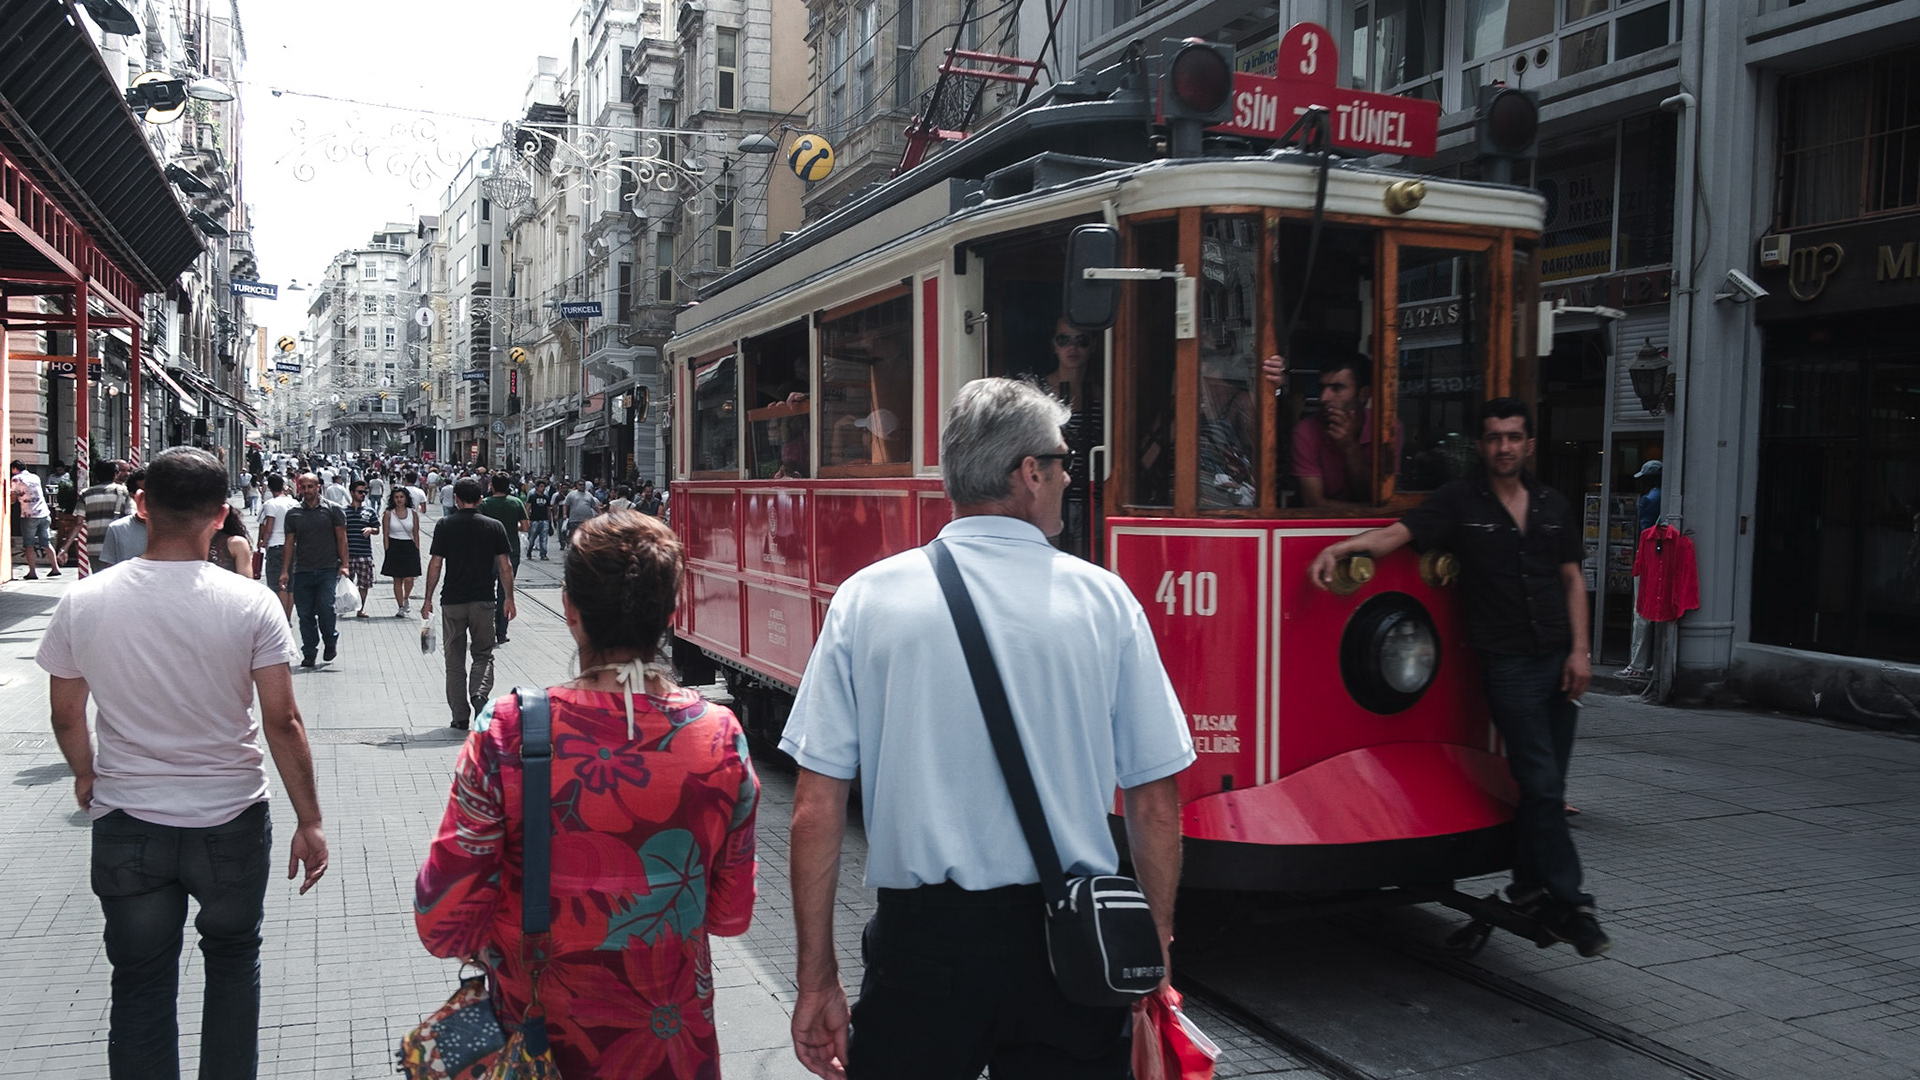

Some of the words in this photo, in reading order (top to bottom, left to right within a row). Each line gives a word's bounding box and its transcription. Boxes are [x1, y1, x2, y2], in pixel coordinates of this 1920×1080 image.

[1300, 32, 1319, 75] 3
[1233, 85, 1278, 132] SİM
[1336, 99, 1413, 148] TÜNEL
[1876, 241, 1920, 281] M
[233, 283, 276, 296] TURKCELL
[562, 305, 600, 314] TURKCELL
[51, 362, 101, 373] HOEL
[277, 363, 300, 371] TURKCELL
[1155, 570, 1218, 616] 410
[1192, 714, 1238, 731] YASAK
